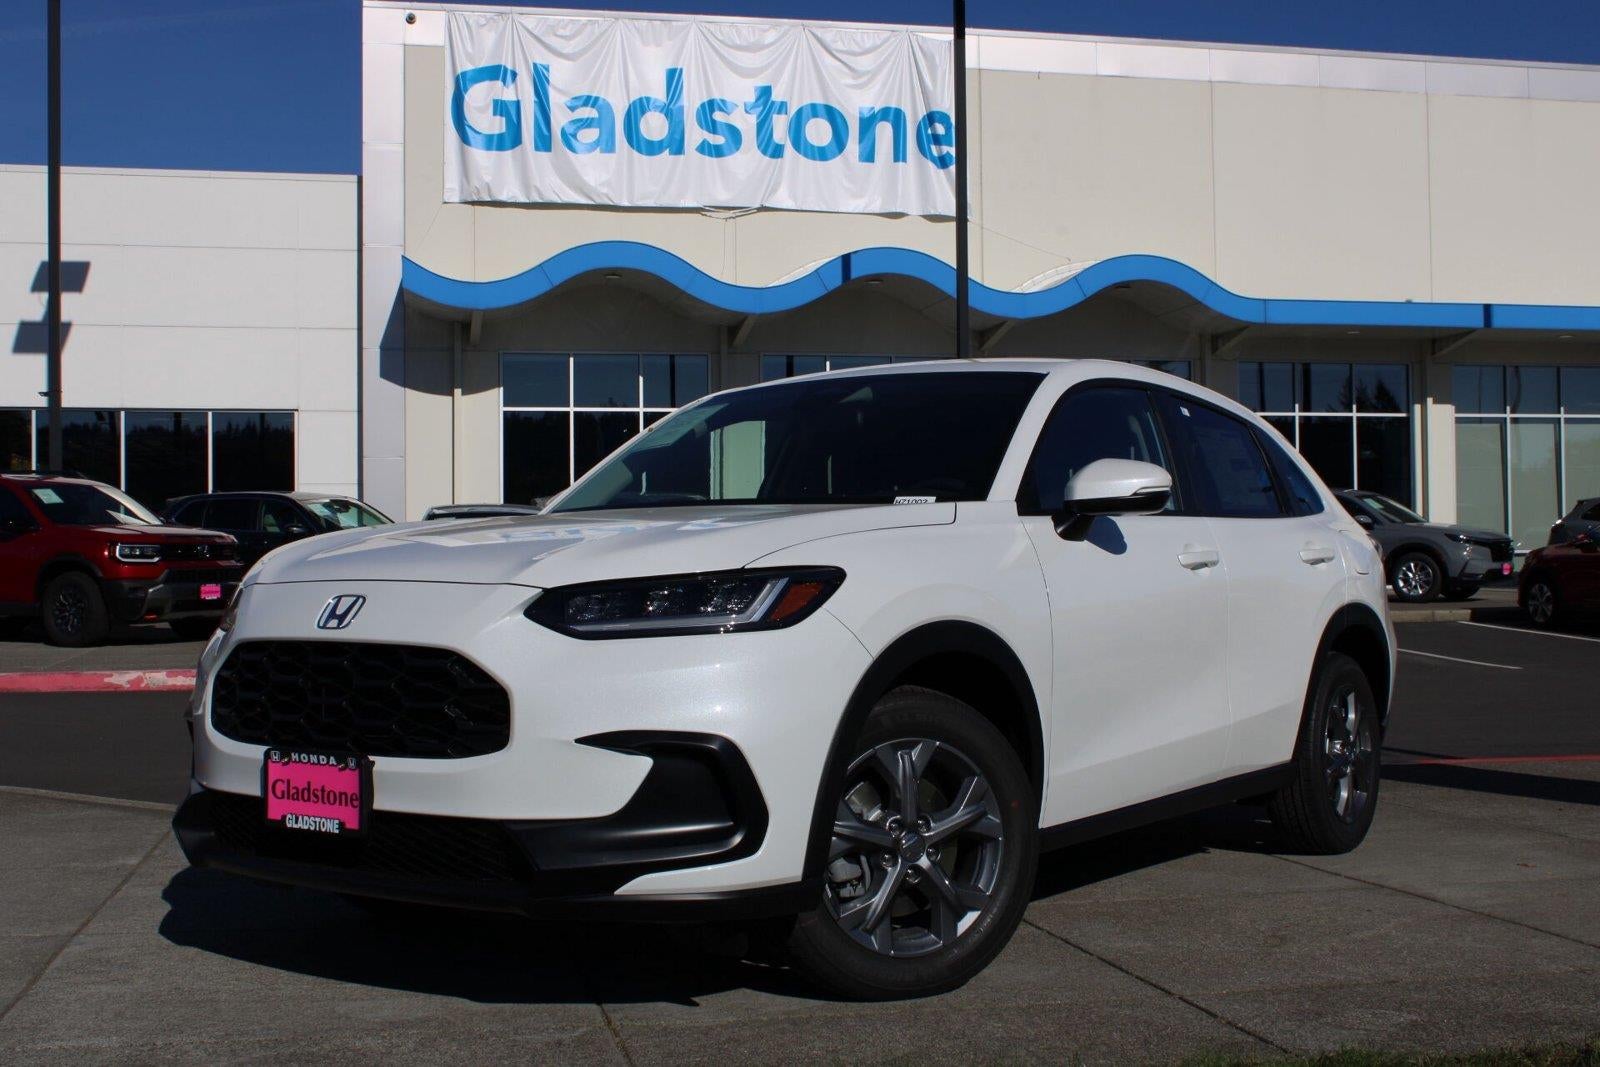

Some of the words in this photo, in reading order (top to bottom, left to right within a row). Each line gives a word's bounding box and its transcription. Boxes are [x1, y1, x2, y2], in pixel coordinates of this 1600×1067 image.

[451, 62, 955, 170] Gladstone
[291, 752, 337, 765] HONDA
[271, 778, 359, 808] Gladstone
[285, 813, 340, 834] GLADSTONE
